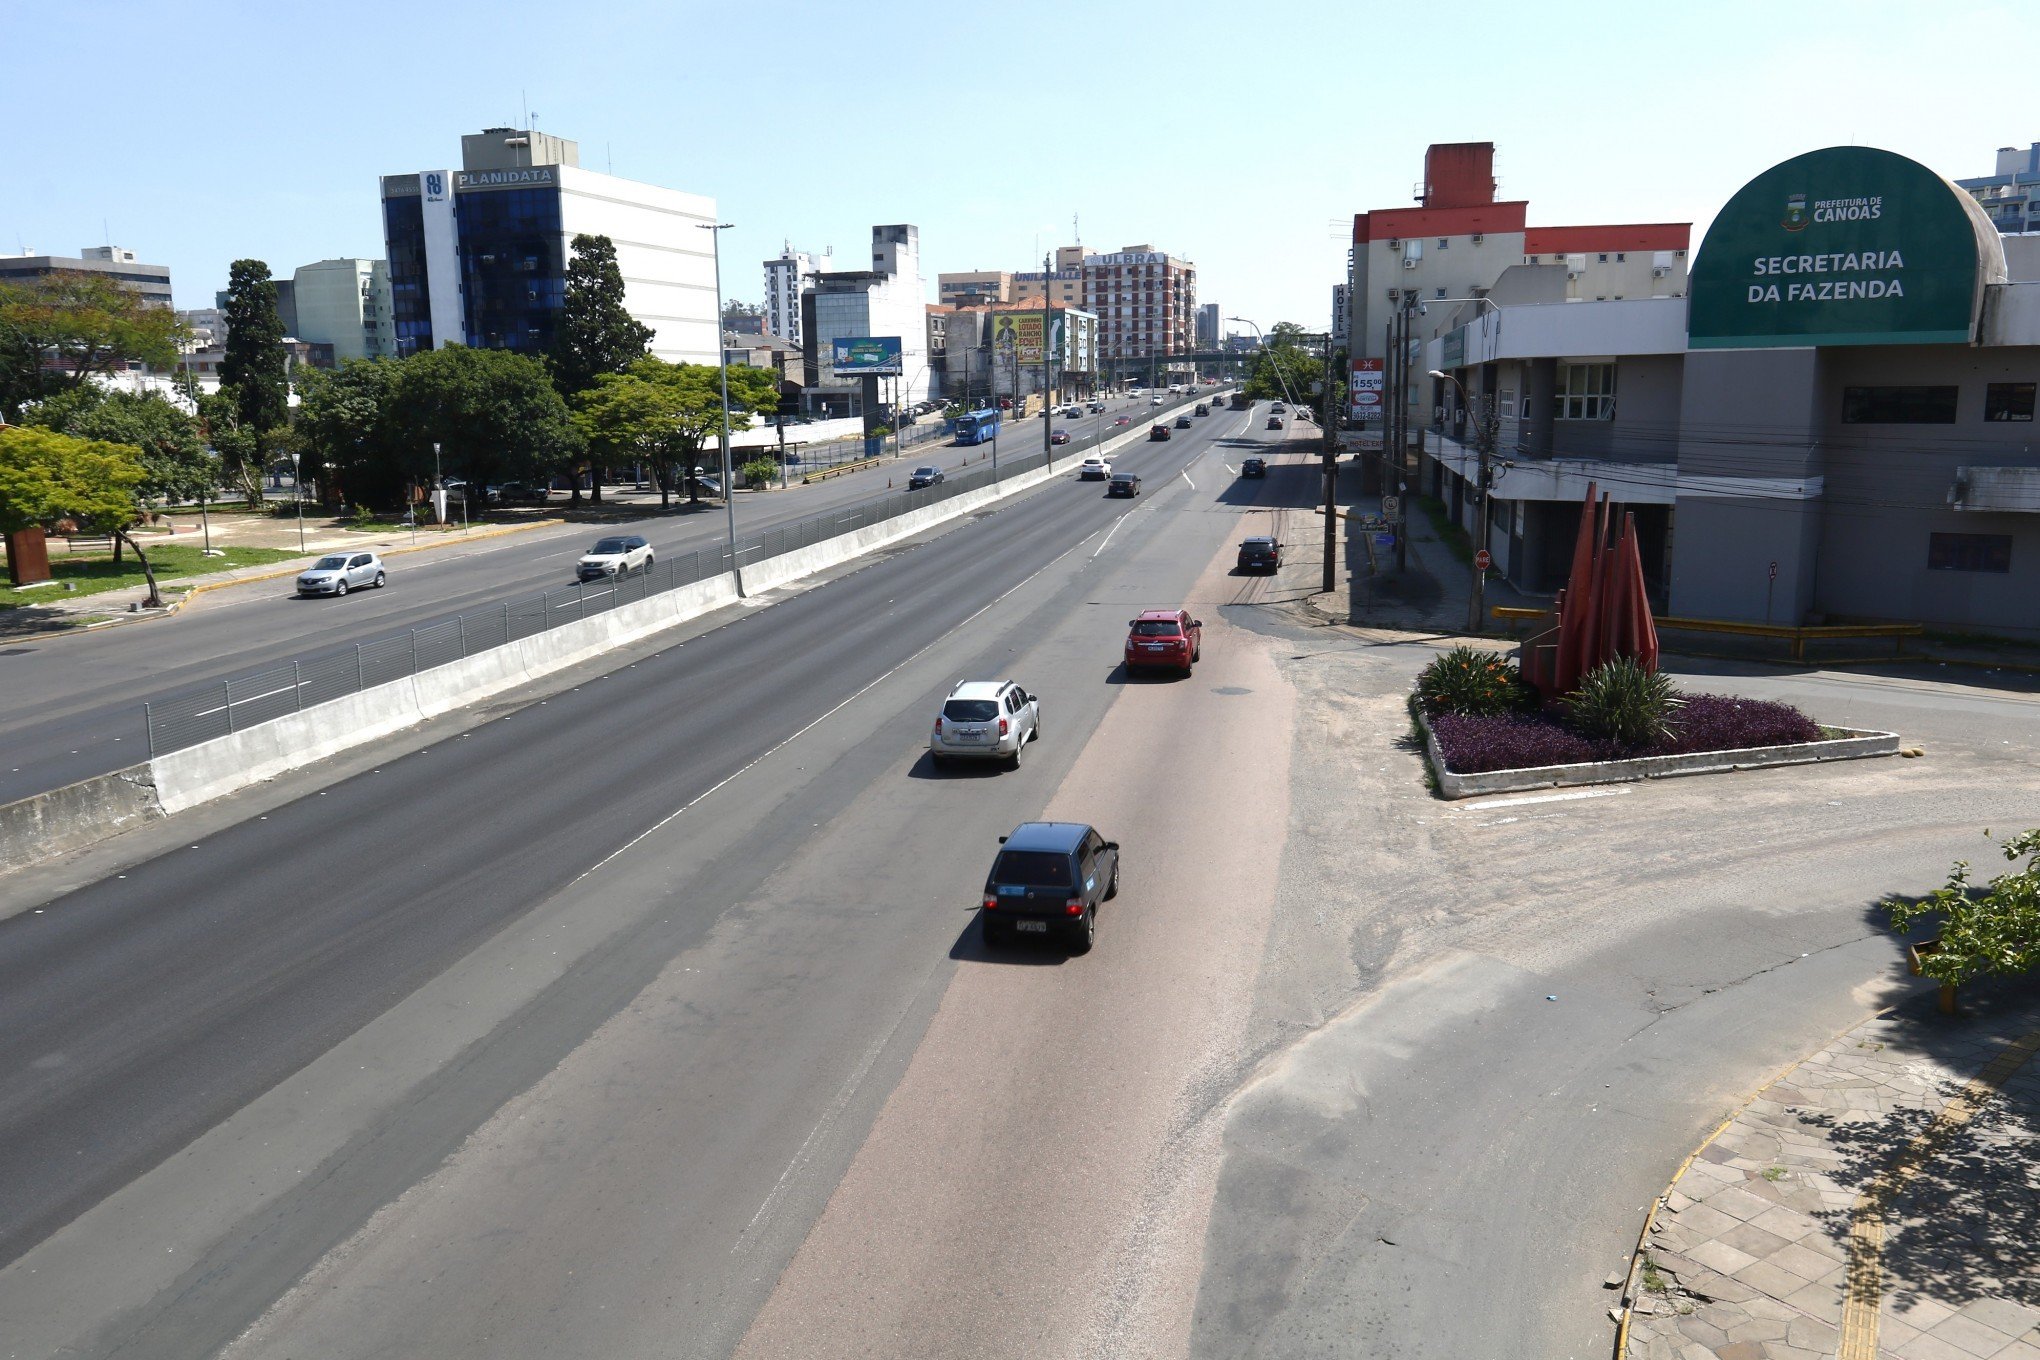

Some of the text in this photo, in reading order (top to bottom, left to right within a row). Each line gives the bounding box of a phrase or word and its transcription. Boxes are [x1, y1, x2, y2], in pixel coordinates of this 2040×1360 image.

[459, 169, 552, 185] PLANIDATA
[1814, 196, 1882, 209] PREFEITURA DE
[1814, 205, 1881, 222] CANOAS
[1102, 253, 1158, 265] ULBRA
[1753, 250, 1904, 276] SECRETARIA
[1748, 279, 1904, 303] DA FAZENDA
[1336, 287, 1345, 331] HOTEL
[1018, 337, 1042, 347] FORT!
